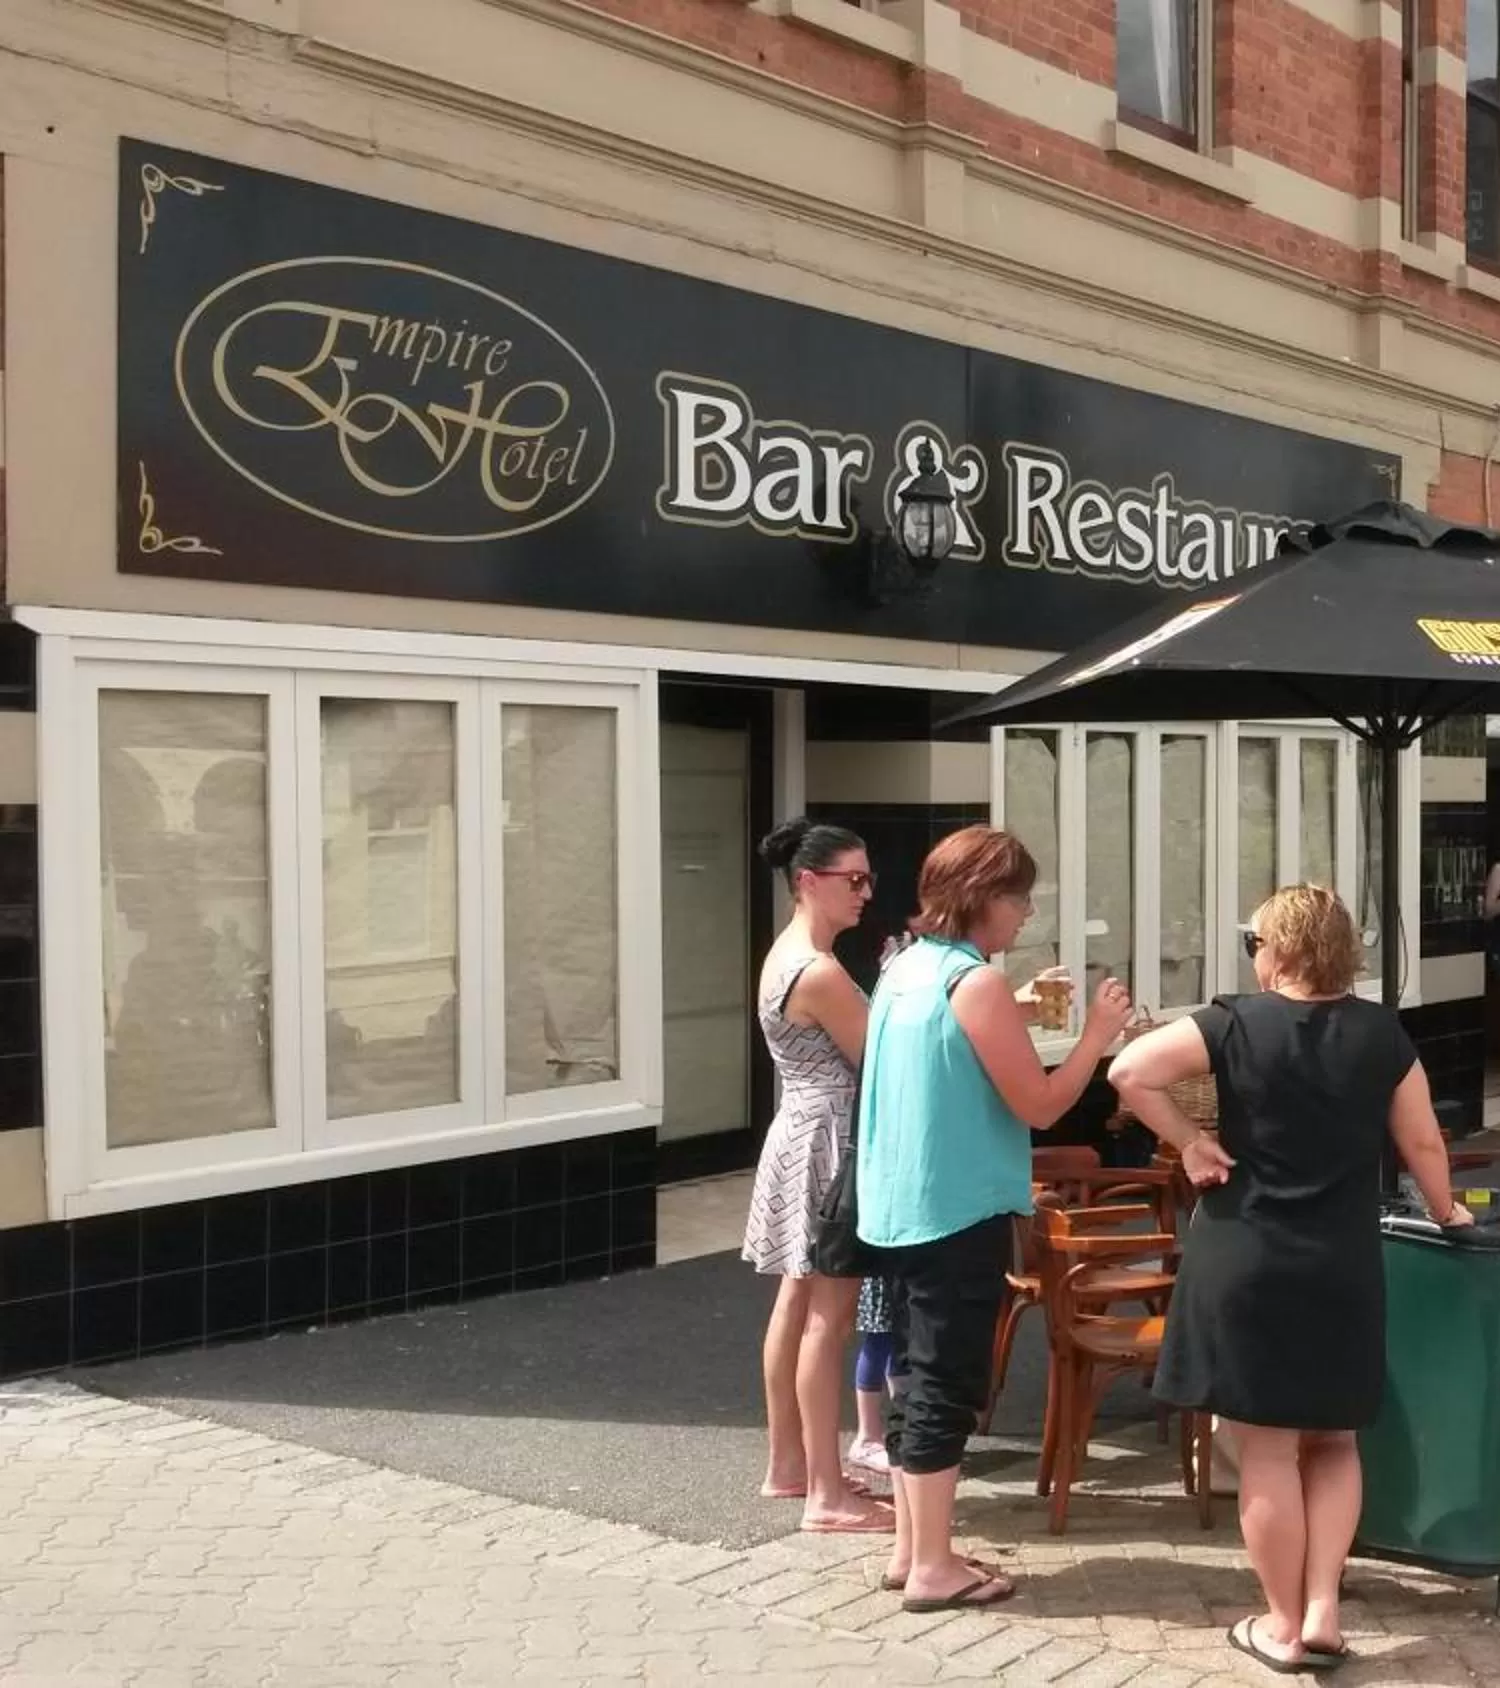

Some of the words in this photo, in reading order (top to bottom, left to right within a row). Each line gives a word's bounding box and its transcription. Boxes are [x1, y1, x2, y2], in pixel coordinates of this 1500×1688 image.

[213, 301, 513, 430] Empire
[668, 388, 865, 530] Bar
[1011, 454, 1309, 583] Restaur
